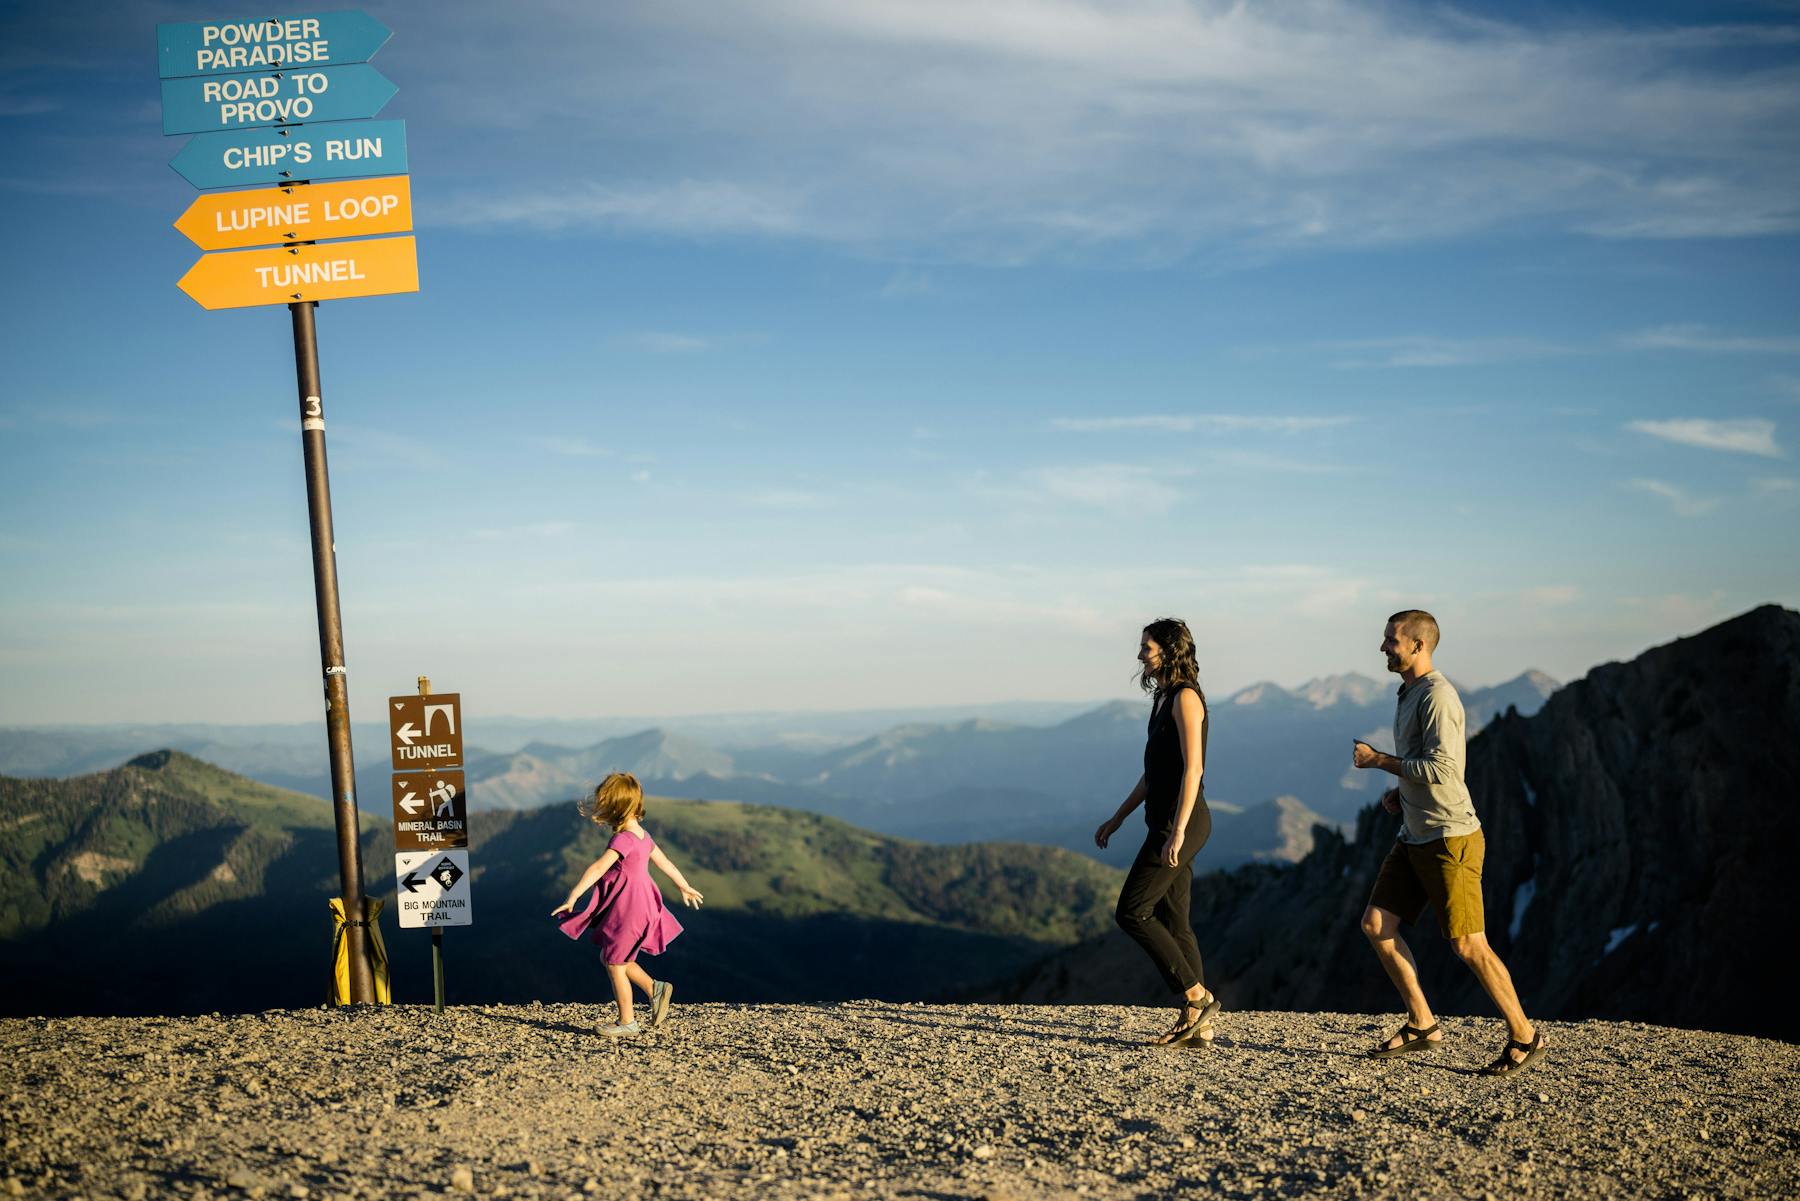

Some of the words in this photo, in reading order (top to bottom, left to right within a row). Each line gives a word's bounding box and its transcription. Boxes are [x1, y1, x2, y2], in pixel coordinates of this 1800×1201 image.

[202, 18, 320, 47] POWDER
[197, 40, 329, 70] PARADISE
[203, 76, 279, 103] ROAD
[292, 72, 329, 94] TO
[221, 97, 313, 124] PROVO
[223, 142, 312, 170] CHIP'S
[326, 137, 382, 161] RUN
[216, 203, 310, 233] LUPINE
[324, 194, 398, 222] LOOP
[255, 259, 365, 289] TUNNEL
[306, 396, 321, 416] 3
[397, 744, 456, 760] TUNNEL
[398, 820, 434, 831] MINERAL
[437, 820, 463, 831] BASIN
[416, 832, 445, 842] TRAIL
[404, 901, 418, 910] BIG
[422, 899, 466, 910] MOUNTAIN
[420, 912, 452, 921] TRAIL
